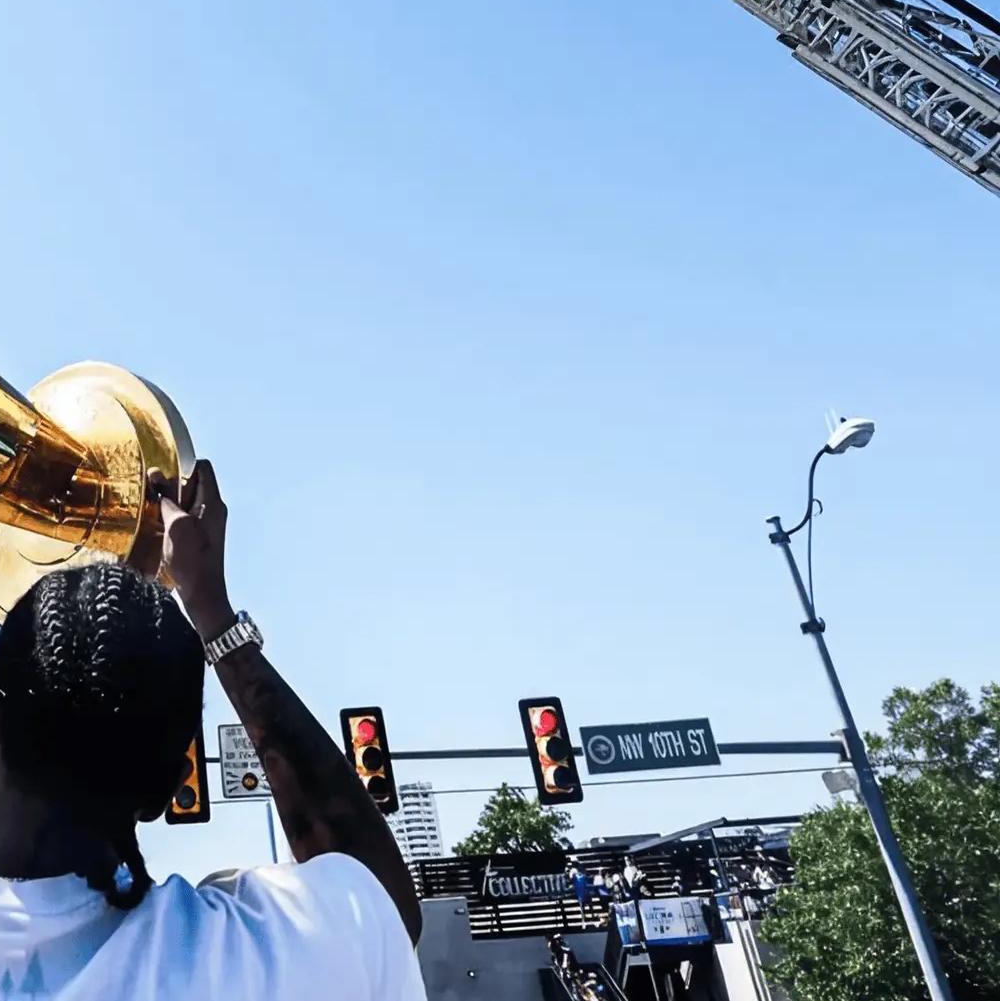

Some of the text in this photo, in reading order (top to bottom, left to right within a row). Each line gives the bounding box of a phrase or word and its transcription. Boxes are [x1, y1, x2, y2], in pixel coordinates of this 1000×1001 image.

[617, 728, 708, 761] NW 10TH ST
